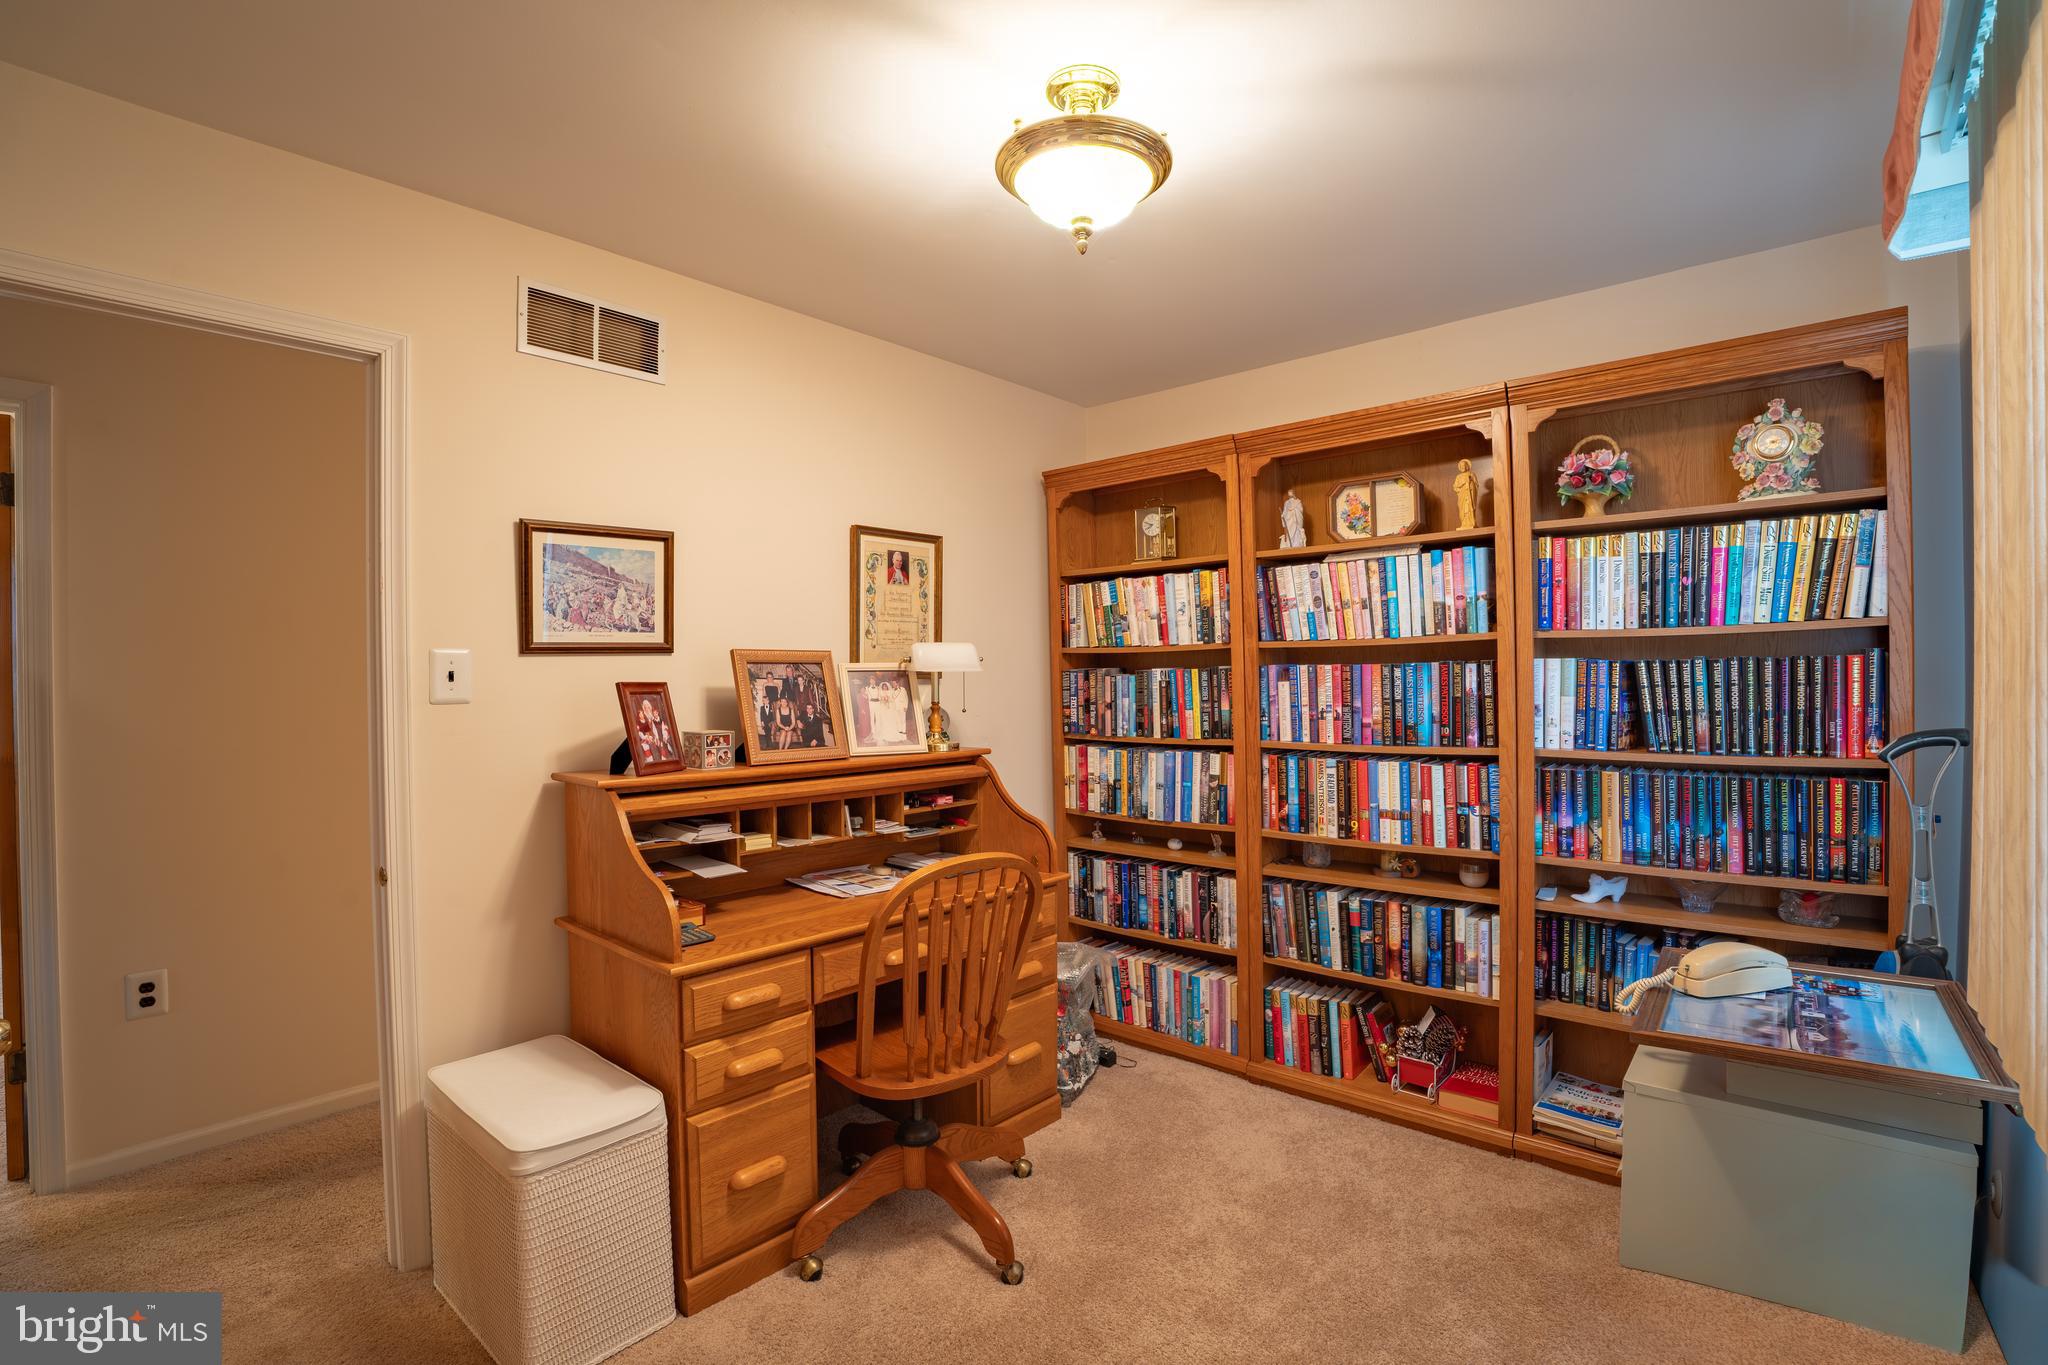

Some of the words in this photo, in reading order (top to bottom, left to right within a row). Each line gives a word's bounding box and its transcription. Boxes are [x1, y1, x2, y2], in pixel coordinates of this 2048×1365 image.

[1862, 521, 1871, 540] nancy
[1555, 540, 1563, 562] DANIELLE
[1668, 533, 1678, 561] DANIELLE
[1683, 534, 1691, 556] DANIELLE
[1700, 532, 1710, 560] DANIELLE
[1763, 545, 1776, 567] DANIELLE
[1860, 541, 1869, 562] thayer
[1555, 563, 1563, 576] STEEL
[1668, 562, 1678, 579] STEEL
[1683, 557, 1691, 571] STEEL
[1700, 561, 1709, 578] STEEL
[1811, 578, 1822, 600] IMAGE
[1818, 575, 1829, 604] MIRROR
[1406, 666, 1414, 687] JAMES
[1440, 664, 1448, 686] JAMES
[1638, 663, 1647, 686] STUART
[1653, 663, 1661, 685] STUART
[1682, 663, 1691, 686] STUART
[1695, 659, 1703, 682] STUART
[1713, 663, 1721, 686] STUART
[1764, 661, 1772, 684] STUART
[1797, 659, 1805, 683] STUART
[1852, 657, 1860, 681] STUART
[1598, 688, 1606, 711] WOODS
[1641, 688, 1651, 713] WOODS
[1671, 688, 1679, 710] WOODS
[1697, 686, 1705, 709] WOODS
[1714, 687, 1722, 711] WOODS
[1765, 686, 1773, 711] WOODS
[1797, 685, 1805, 710] WOODS
[1852, 682, 1860, 706] WOODS
[1869, 677, 1877, 704] WOODS
[1407, 688, 1415, 726] PATTERSON
[1417, 687, 1425, 725] PATTERSON
[1441, 687, 1449, 725] PATTERSON
[1343, 713, 1351, 738] PATTERSON
[1327, 774, 1335, 789] BEACH
[1745, 781, 1753, 805] STUART
[1327, 790, 1335, 804] ROAD
[1763, 782, 1771, 805] STUART
[1816, 783, 1824, 808] STUART
[1834, 783, 1842, 808] STUART
[1851, 784, 1859, 809] STUART
[1351, 820, 1359, 831] 9
[1668, 802, 1676, 826] WOODS
[1763, 807, 1771, 831] WOODS
[1781, 807, 1789, 831] WOODS
[1834, 810, 1842, 834] WOODS
[1851, 810, 1859, 835] WOODS
[1871, 812, 1879, 838] WOODS
